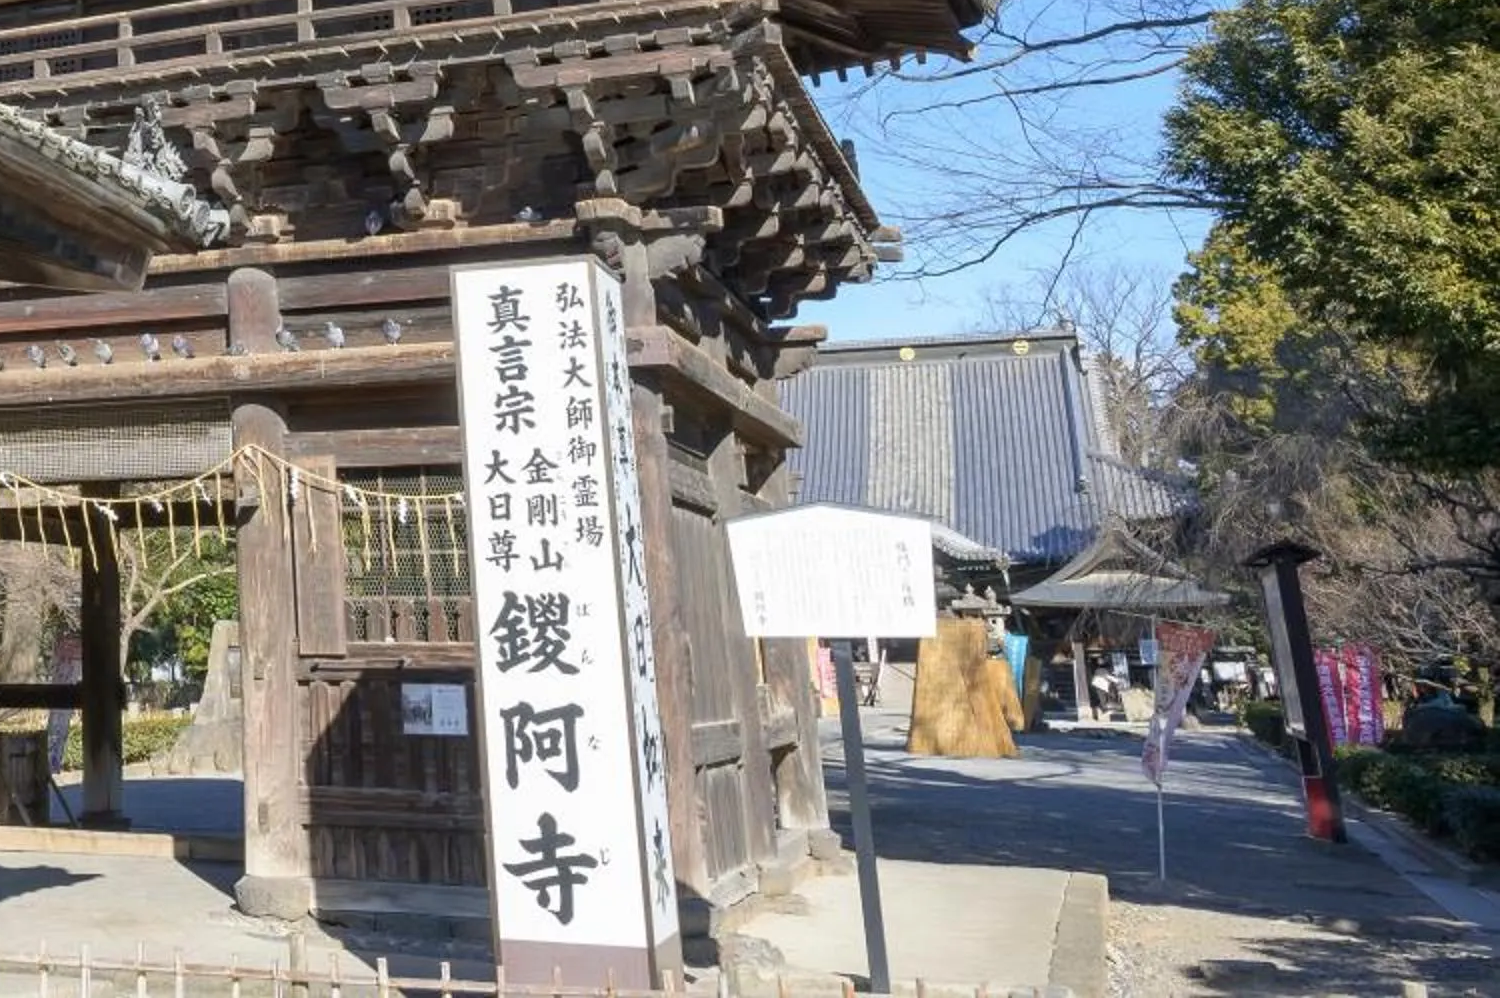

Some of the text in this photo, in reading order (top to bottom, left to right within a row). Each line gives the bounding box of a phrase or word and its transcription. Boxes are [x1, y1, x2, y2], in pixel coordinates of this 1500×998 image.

[487, 285, 536, 435] 真言宗
[555, 281, 604, 549] 弘法大師御霊場
[484, 449, 520, 573] 大日尊
[521, 447, 564, 571] 金剛山
[489, 591, 599, 926] 鑁阿寺
